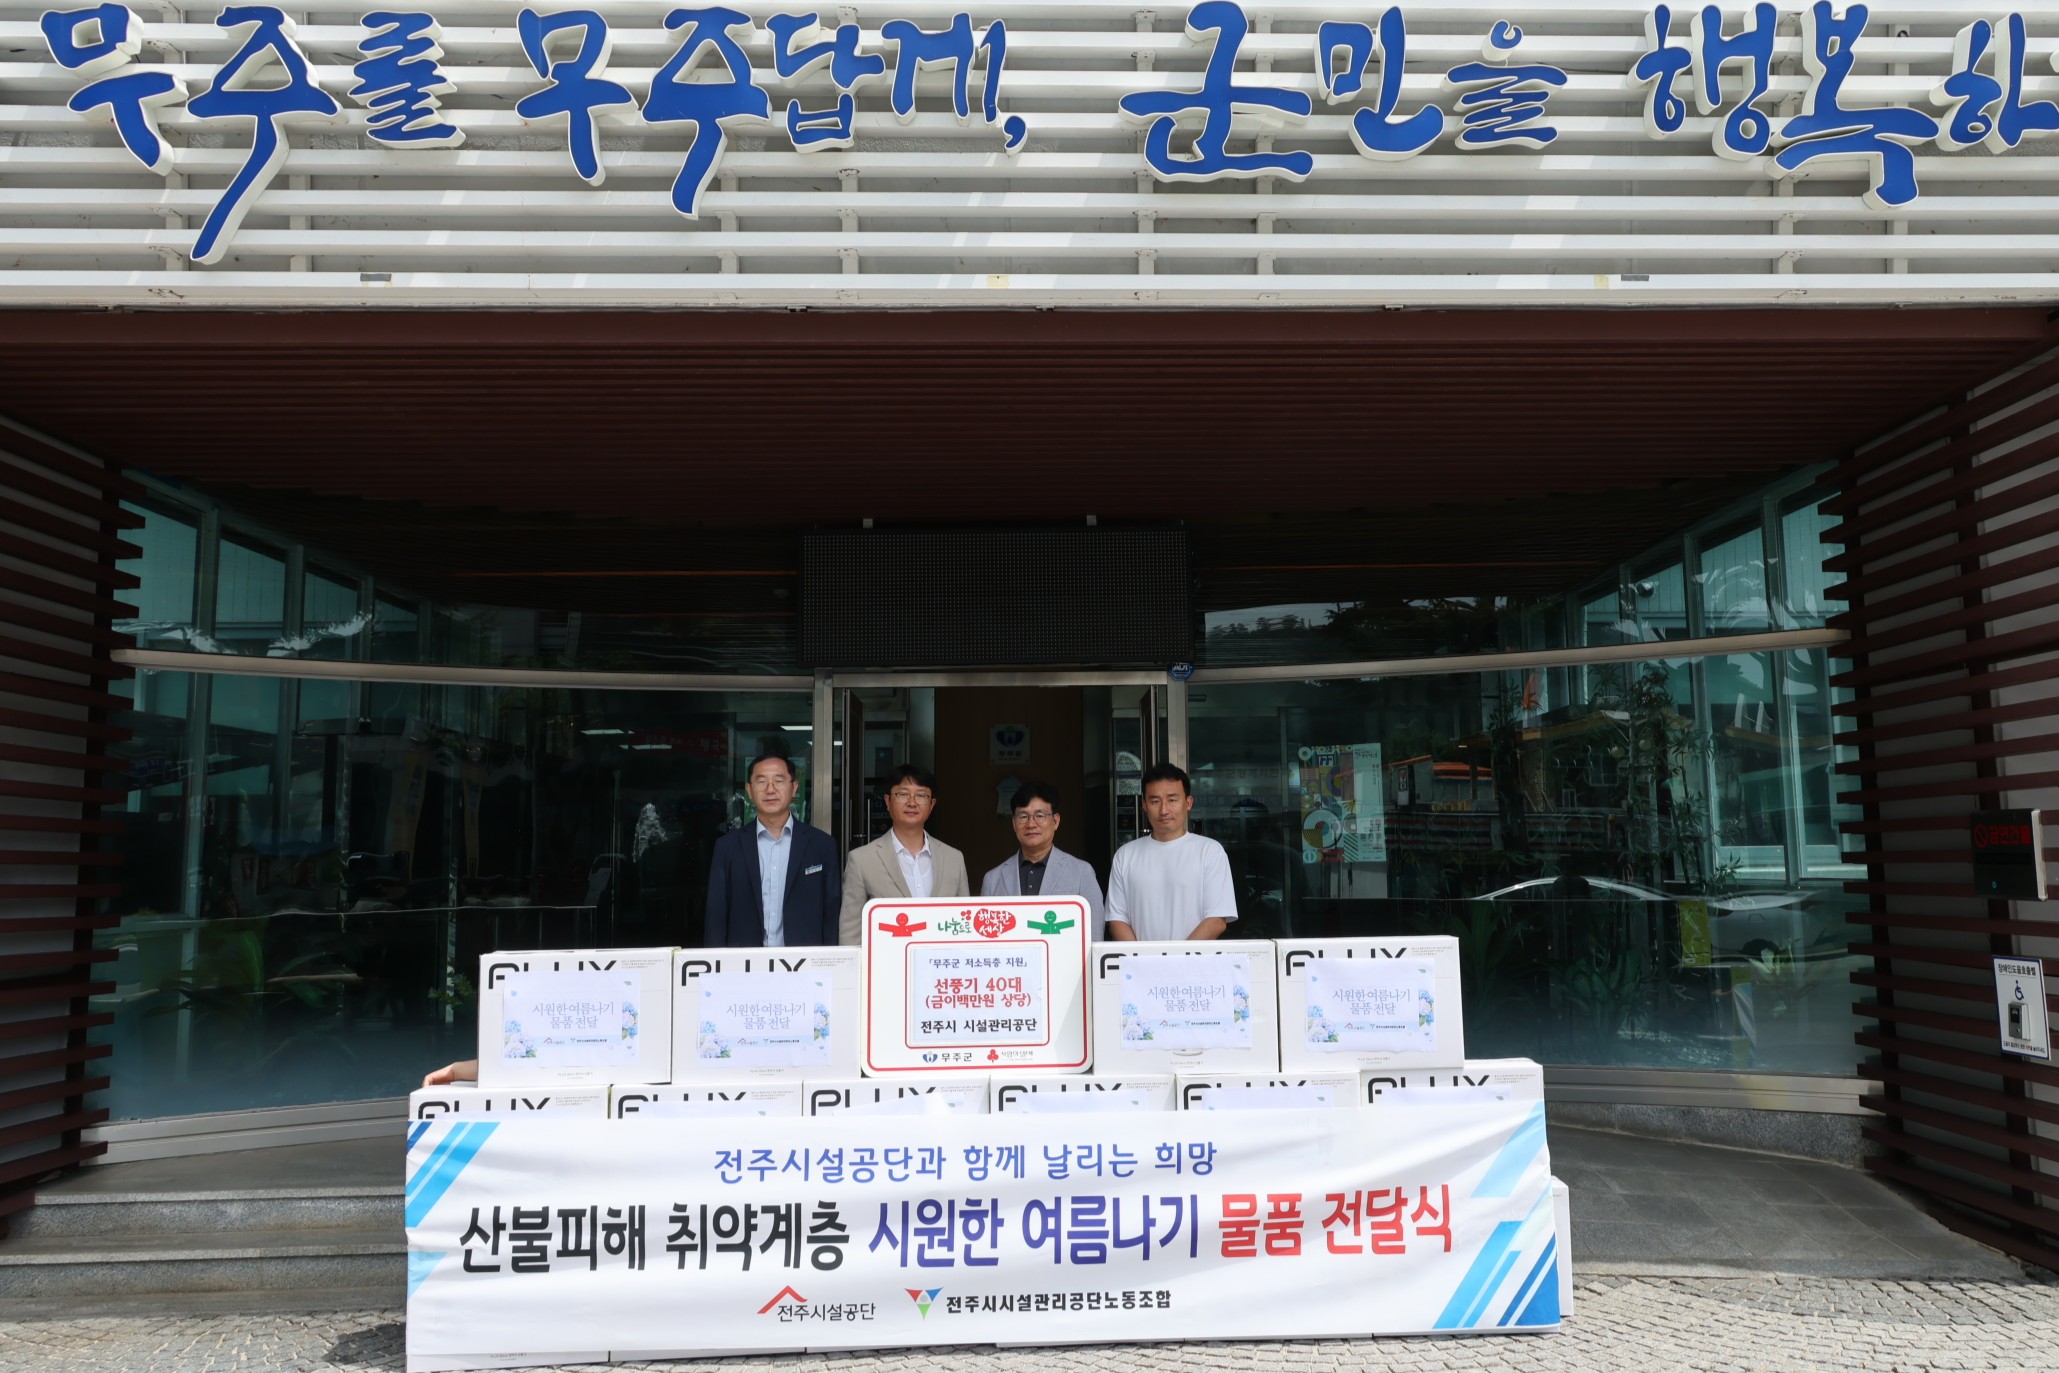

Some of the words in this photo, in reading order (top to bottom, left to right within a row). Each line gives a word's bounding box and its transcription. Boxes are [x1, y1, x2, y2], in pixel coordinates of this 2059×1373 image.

[40, 3, 465, 264] 무주를
[1118, 0, 1569, 184] 군민을
[1623, 0, 2059, 208] 행복하
[937, 917, 972, 936] 나눔으로
[978, 909, 1012, 926] 행복한
[979, 923, 1005, 937] 세상
[964, 957, 1002, 969] 저소득층
[933, 977, 979, 994] 선풍기
[985, 977, 1023, 993] 40대
[925, 992, 996, 1010] (금이백만원
[1000, 992, 1032, 1008] 상당)
[920, 1019, 957, 1035] 전주시
[962, 1017, 1038, 1033] 시설관리공단
[941, 1052, 973, 1063] 무주군
[713, 1145, 947, 1185] 전주시설공단과
[962, 1144, 1026, 1182] 함께
[1043, 1143, 1139, 1181] 날리는
[1154, 1141, 1218, 1177] 희망
[459, 1204, 646, 1274] 산불피해
[665, 1199, 851, 1272] 취약계층
[868, 1197, 1005, 1268] 시원한
[1021, 1194, 1199, 1266] 여름나기
[1218, 1193, 1305, 1259] 물품
[1320, 1183, 1452, 1255] 전달식
[946, 1289, 1172, 1314] 전주시시설관리공단노동조합
[778, 1302, 877, 1323] 전주시설공단
